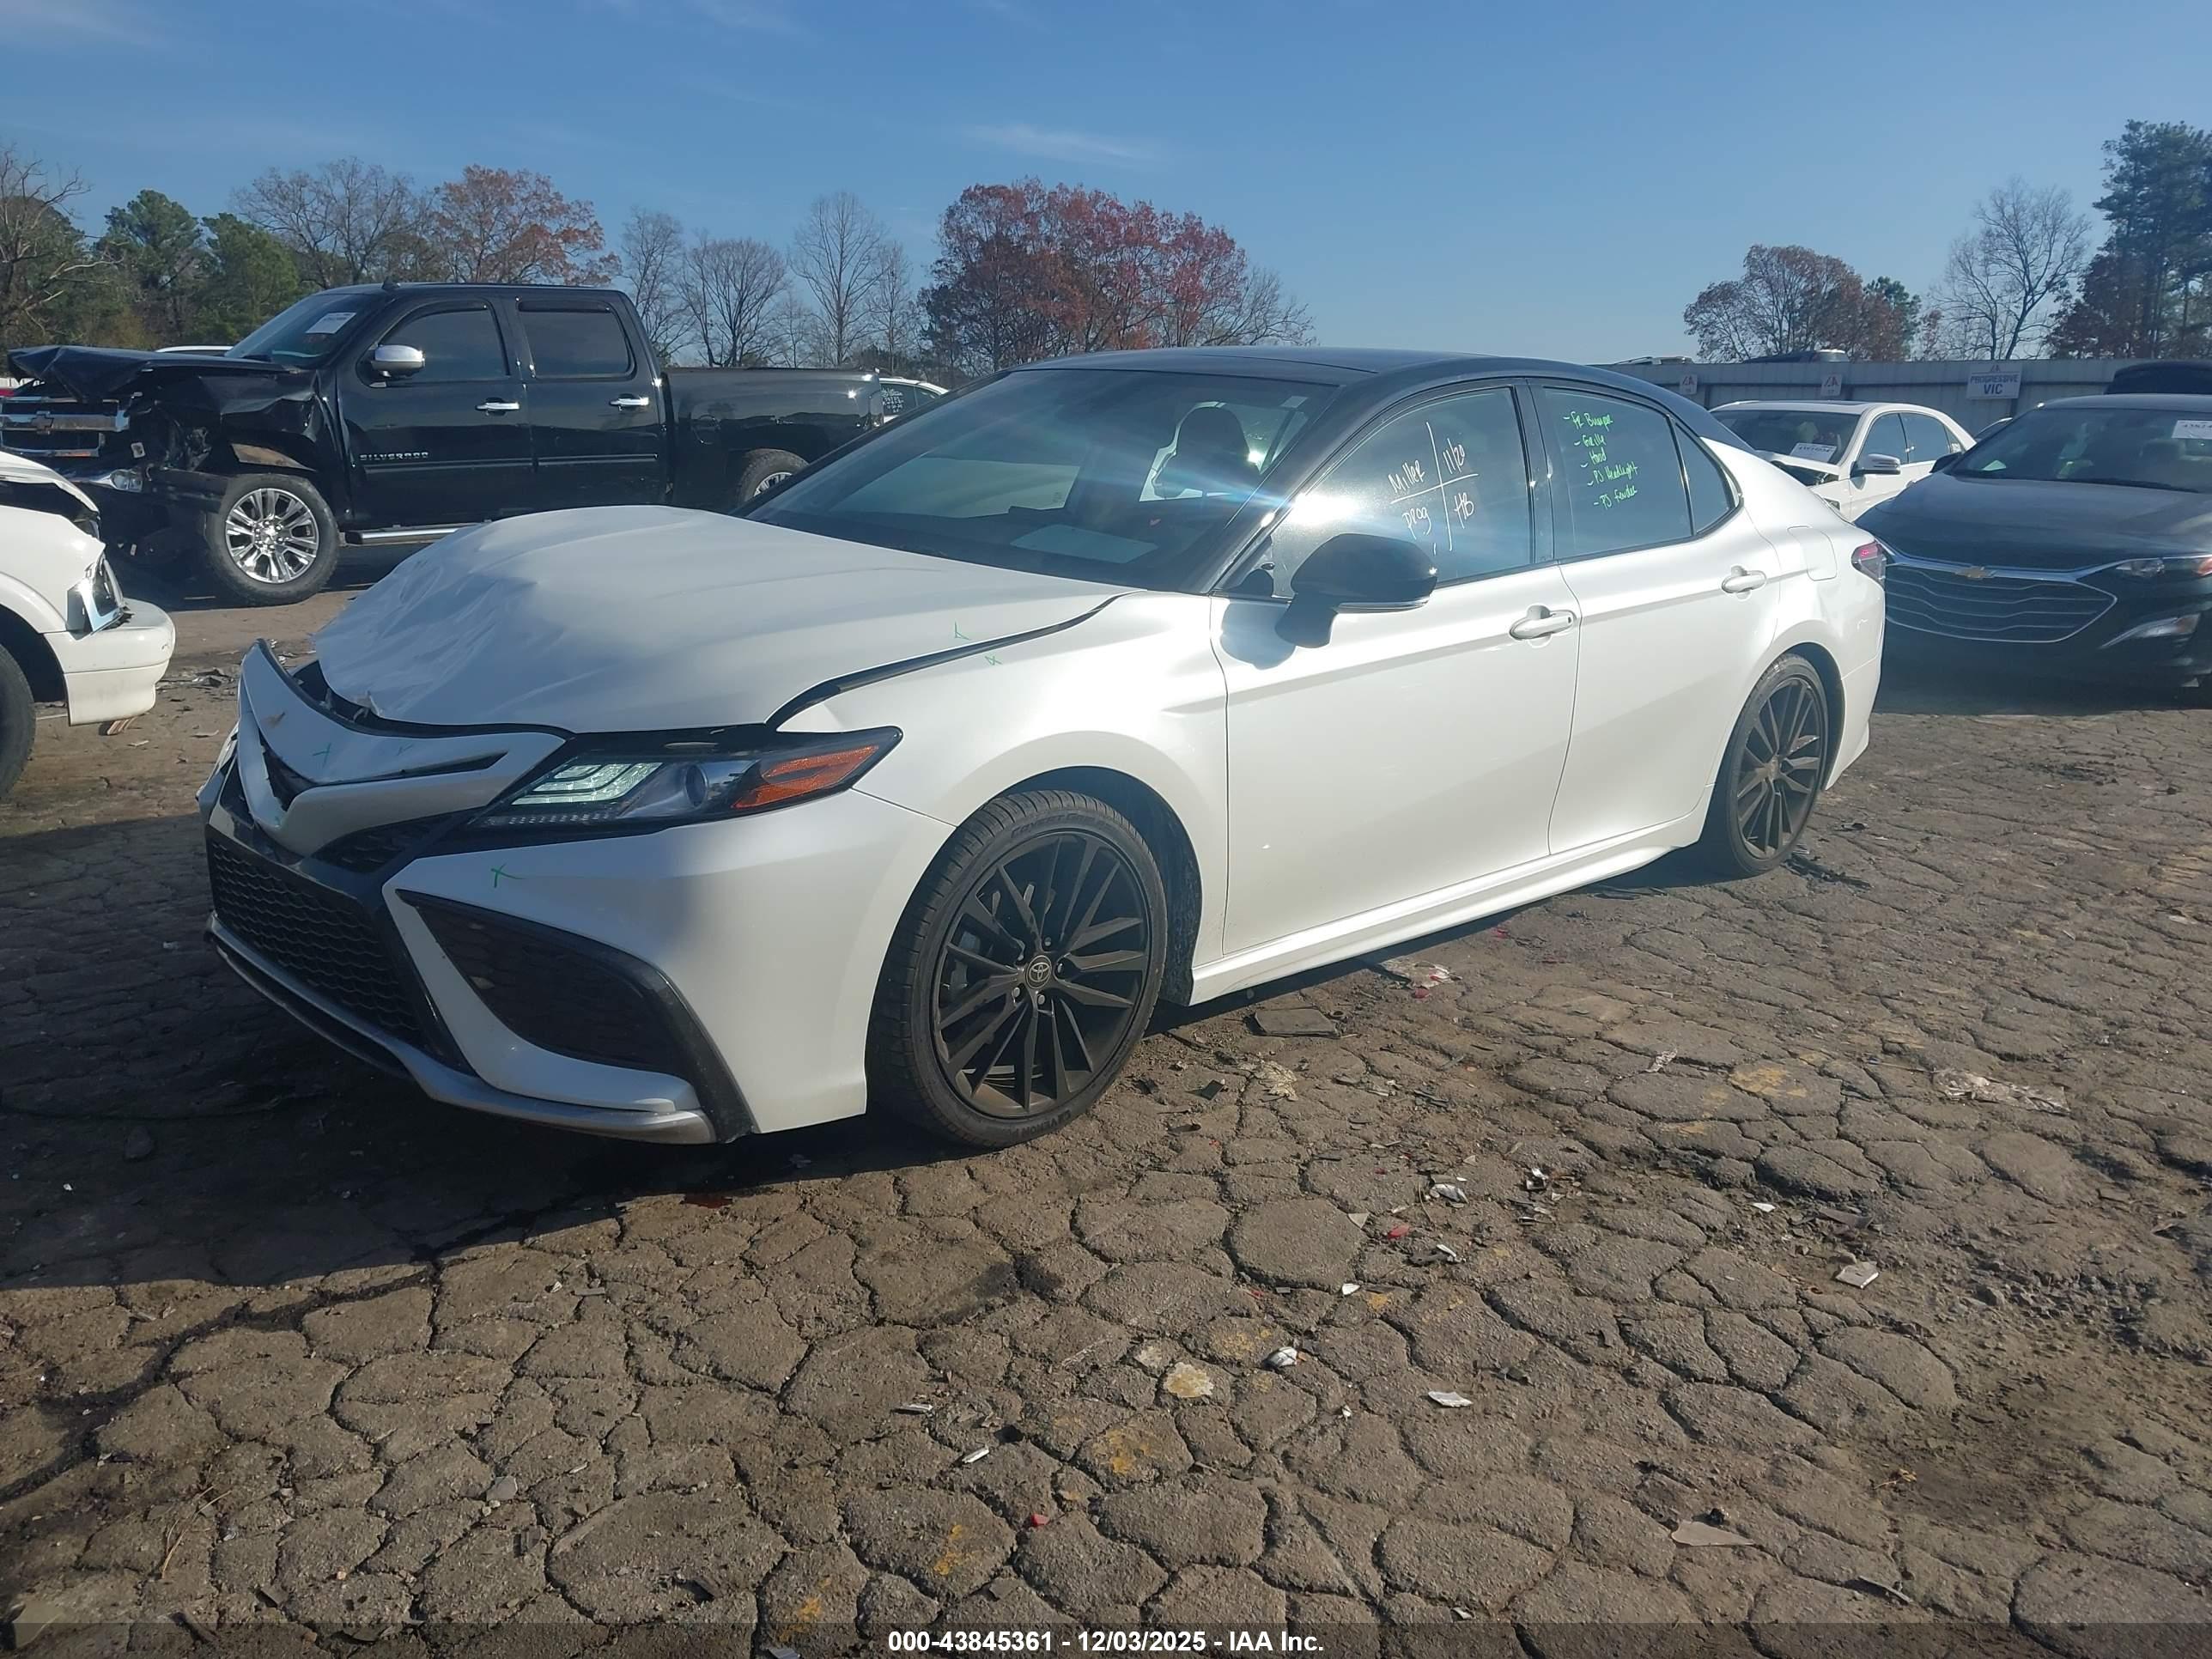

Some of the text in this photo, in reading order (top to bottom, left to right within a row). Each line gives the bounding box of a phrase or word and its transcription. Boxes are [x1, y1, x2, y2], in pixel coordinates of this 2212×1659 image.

[1970, 374, 2019, 384] PROGRESSIVE
[1984, 384, 2003, 394] VIC
[360, 452, 428, 460] SILVERADO
